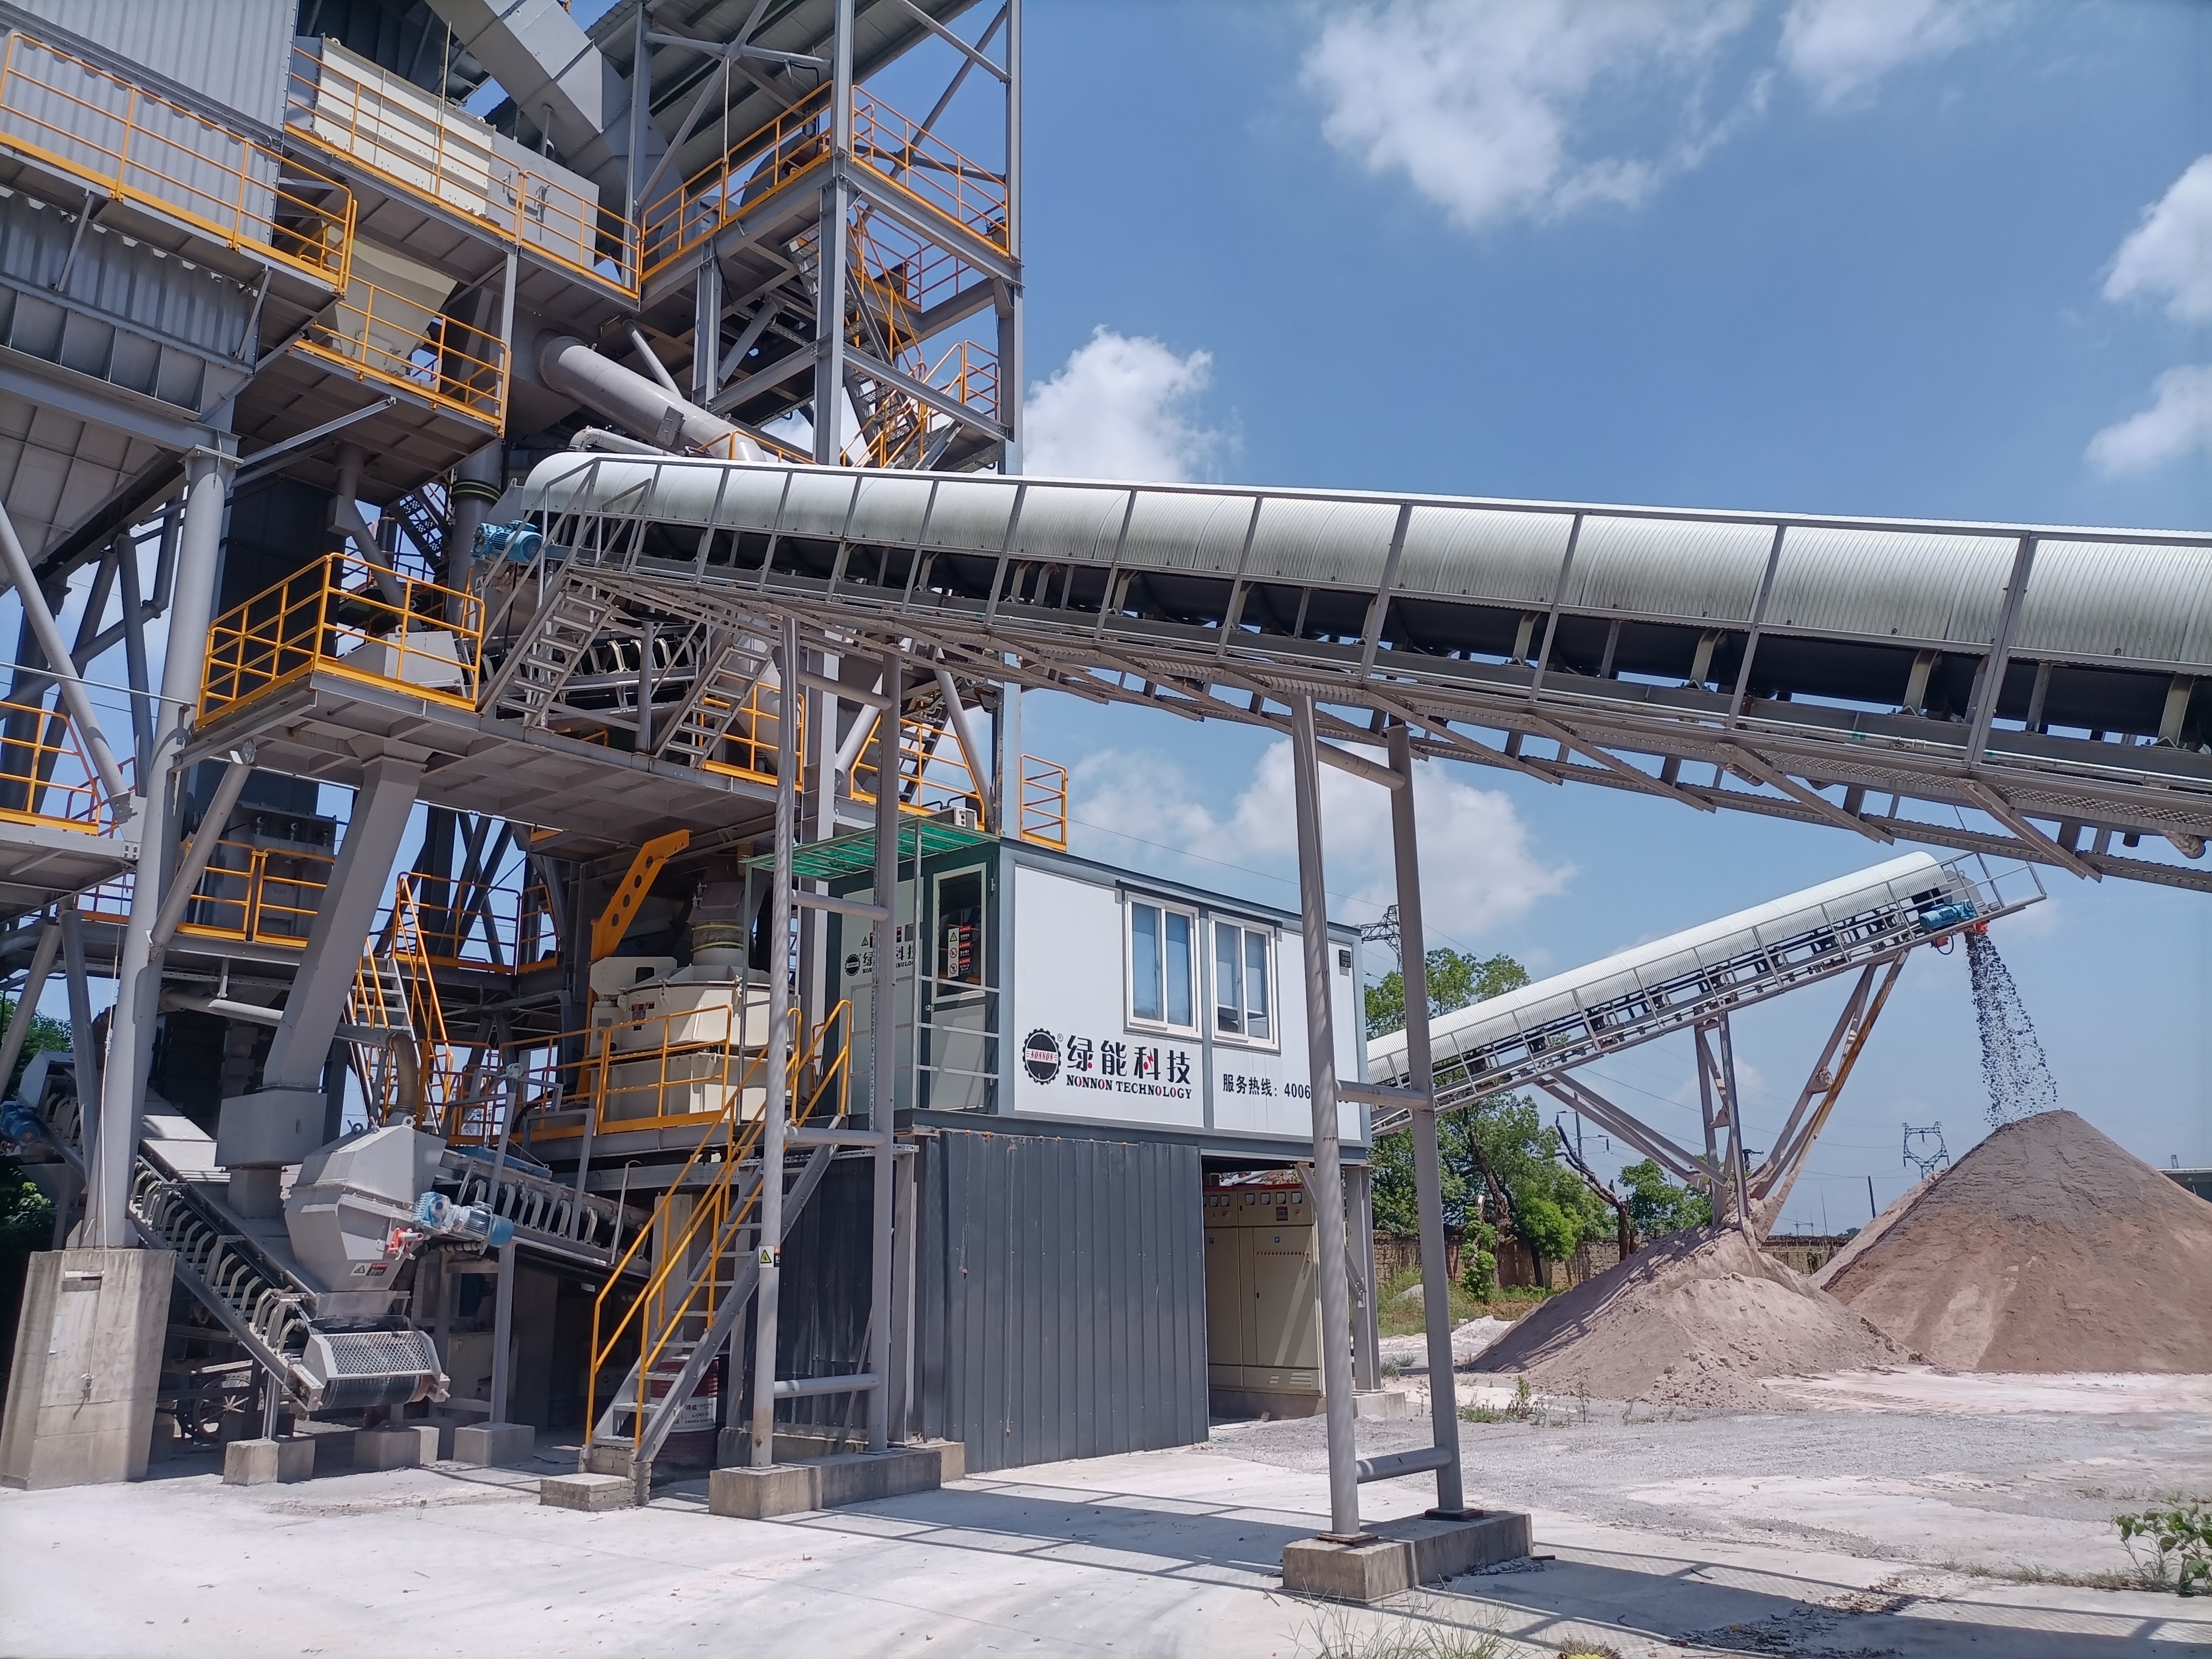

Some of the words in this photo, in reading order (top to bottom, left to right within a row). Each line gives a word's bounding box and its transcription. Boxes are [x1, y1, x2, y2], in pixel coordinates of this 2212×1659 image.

[1030, 1050, 1054, 1062] NONNON
[1067, 1035, 1191, 1085] 绿能科技
[1066, 1074, 1113, 1091] NONNON
[1116, 1081, 1192, 1099] TECHNOLOGY
